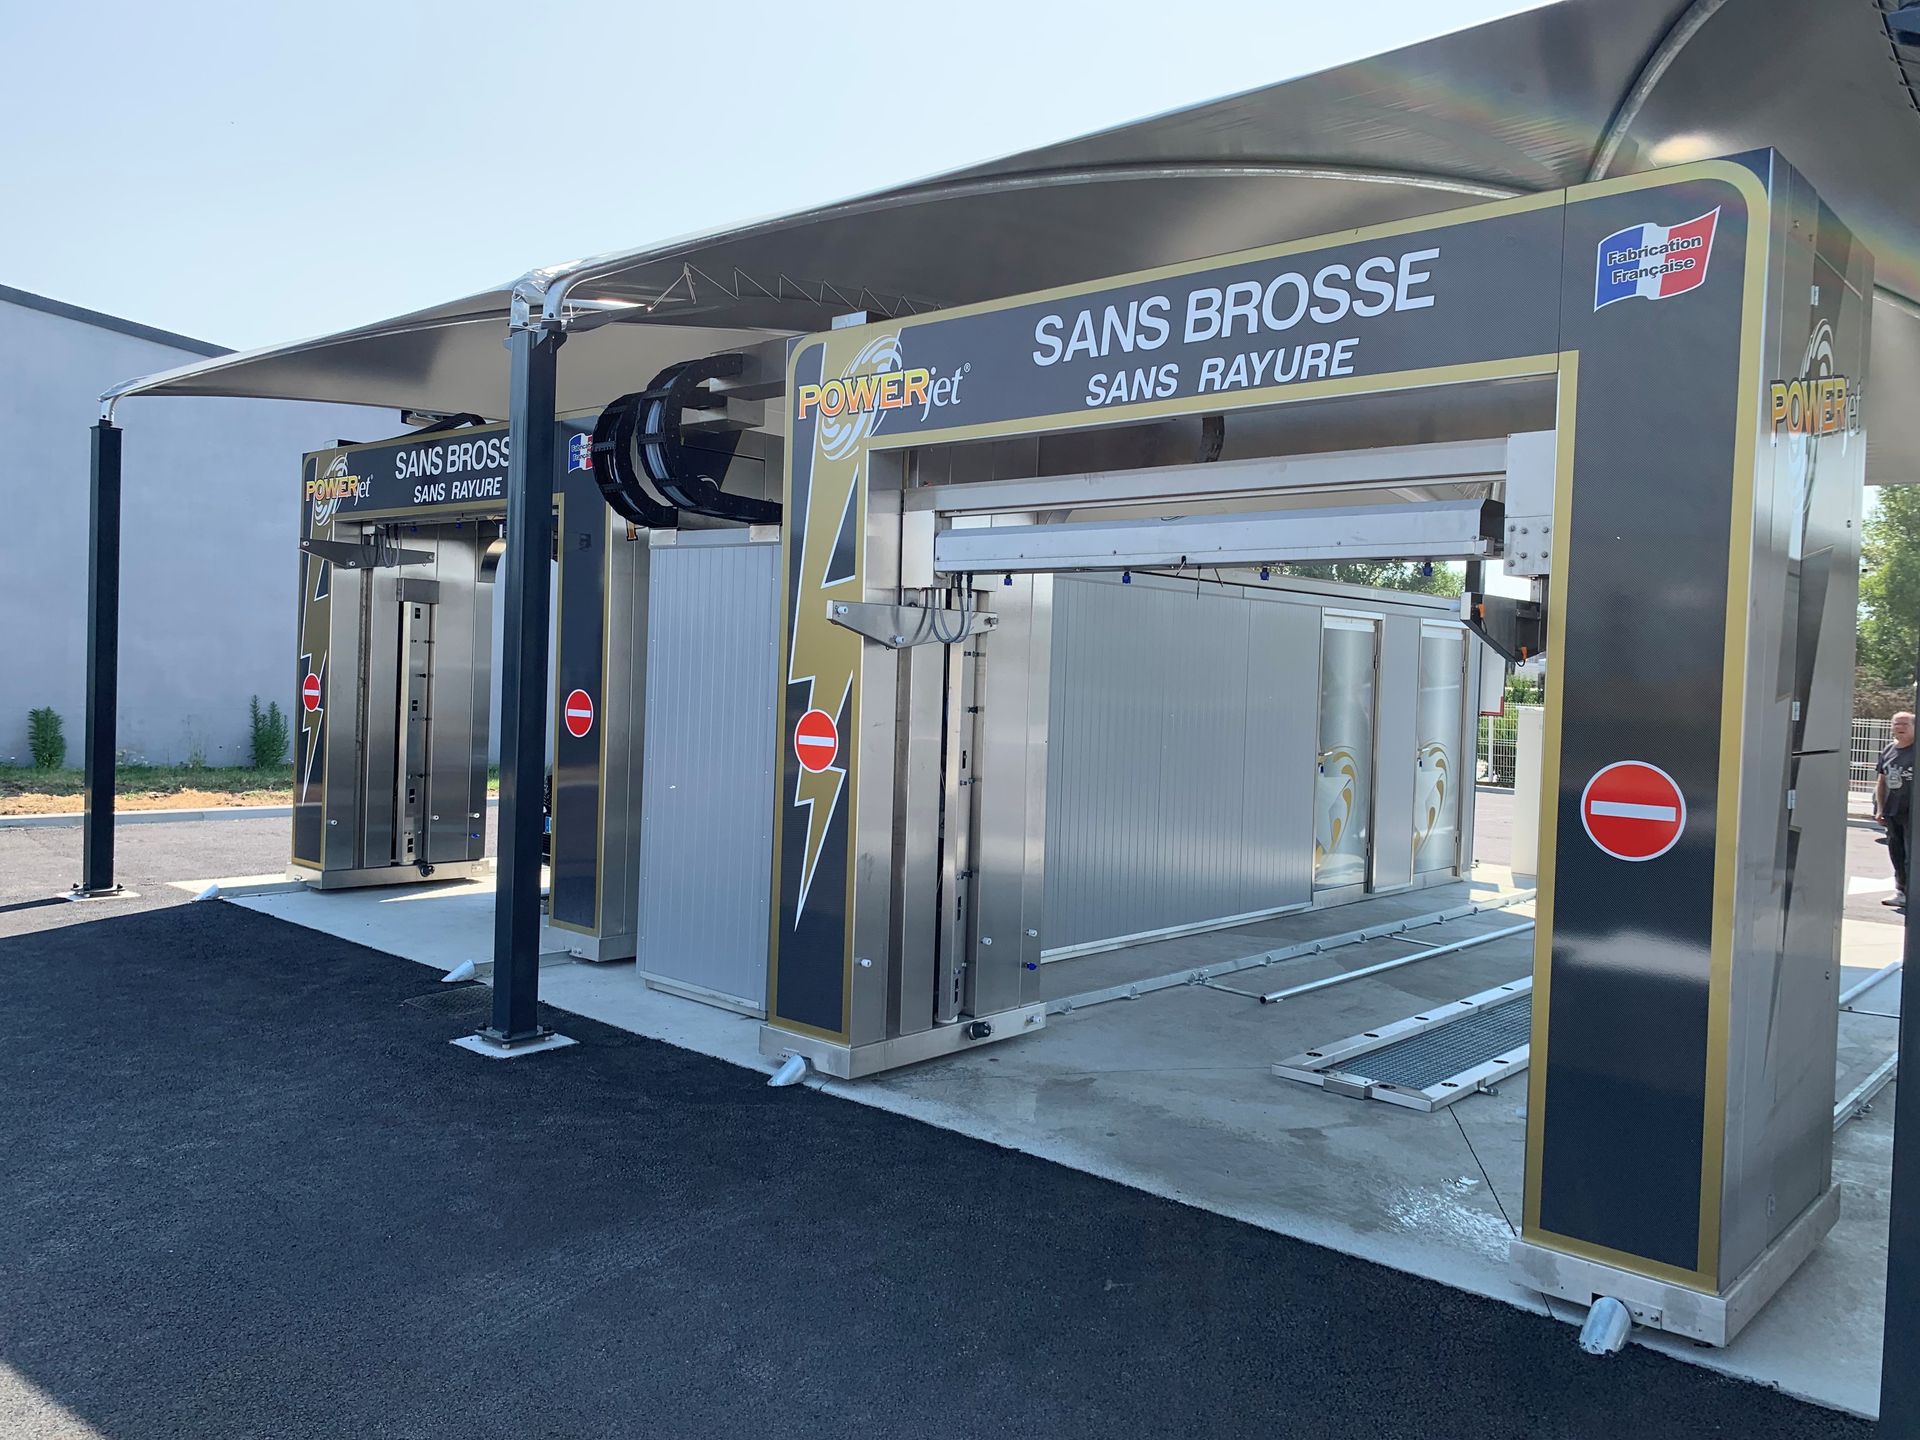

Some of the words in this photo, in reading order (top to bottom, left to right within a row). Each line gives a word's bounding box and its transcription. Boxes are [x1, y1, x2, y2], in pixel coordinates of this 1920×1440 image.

[1607, 236, 1703, 266] Fabrication
[1612, 258, 1696, 285] Française
[1032, 296, 1171, 367] SANS
[1183, 247, 1441, 344] BROSSE
[1085, 363, 1179, 407] SANS
[1197, 337, 1360, 393] RAYURE
[395, 446, 443, 480] SANS
[446, 436, 510, 473] BROSS
[413, 482, 446, 503] SANS
[451, 477, 503, 499] RAYURE
